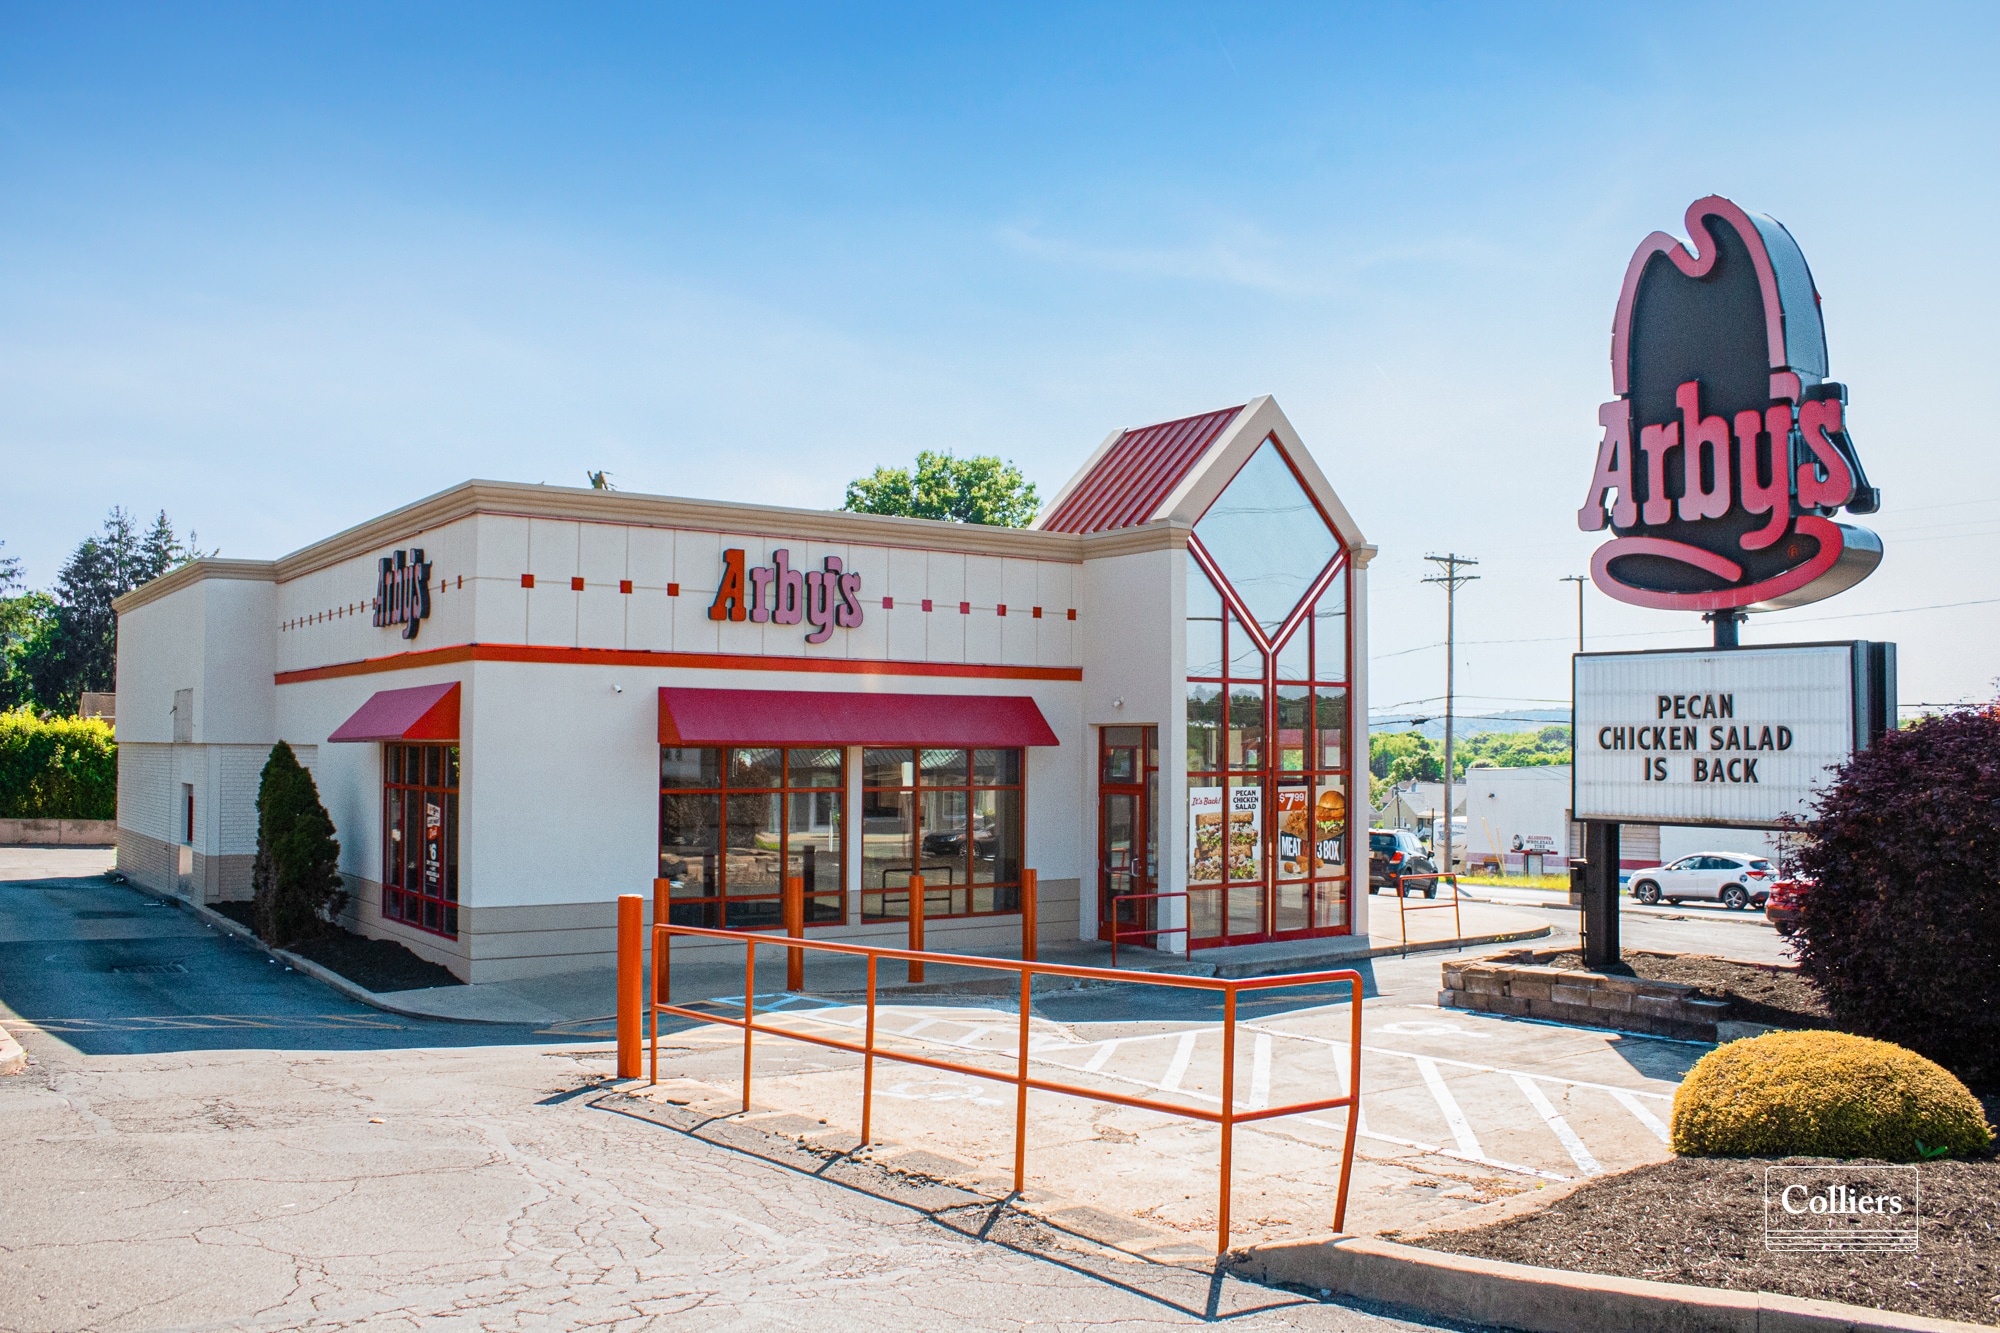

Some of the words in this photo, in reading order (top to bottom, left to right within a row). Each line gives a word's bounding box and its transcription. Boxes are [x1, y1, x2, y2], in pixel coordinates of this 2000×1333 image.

[1578, 371, 1856, 551] Arby's
[373, 548, 432, 639] Arby's
[707, 549, 863, 644] Arby's
[1657, 694, 1734, 719] PECAN
[1598, 726, 1697, 750] CHICKEN
[1709, 726, 1793, 750] SALAD
[1643, 757, 1668, 781] IS
[1693, 758, 1759, 783] BACK
[1191, 797, 1203, 806] It's
[1203, 797, 1221, 806] Back!
[1281, 836, 1301, 857] MEAT
[1316, 842, 1323, 858] 3
[1323, 840, 1340, 861] BOX
